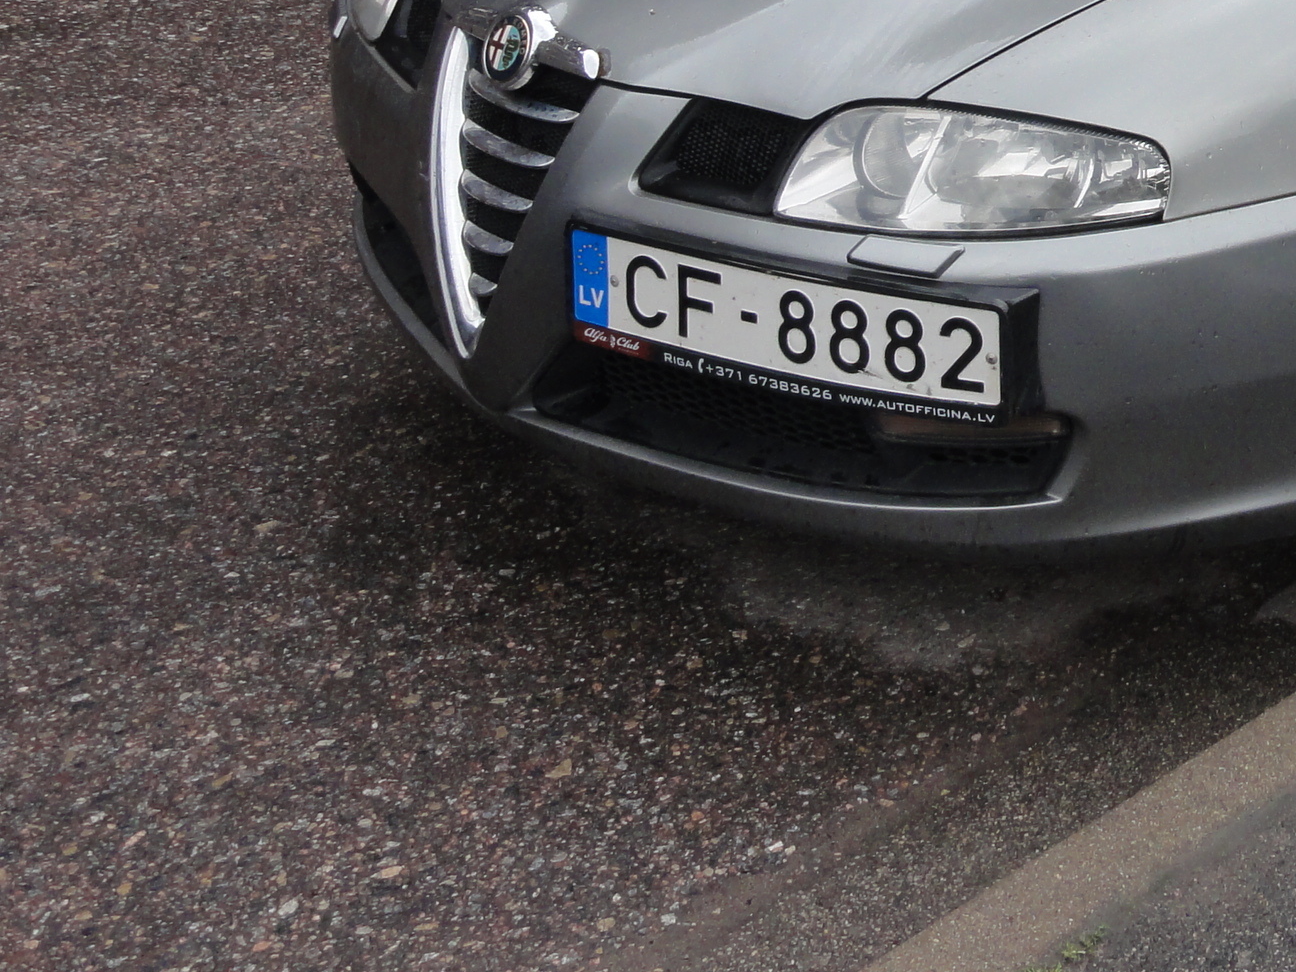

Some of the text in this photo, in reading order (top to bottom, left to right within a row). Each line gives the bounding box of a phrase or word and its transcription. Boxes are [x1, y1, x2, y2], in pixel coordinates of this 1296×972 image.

[578, 284, 605, 309] LV
[583, 327, 640, 351] Alfa Club
[748, 374, 833, 400] 67383626
